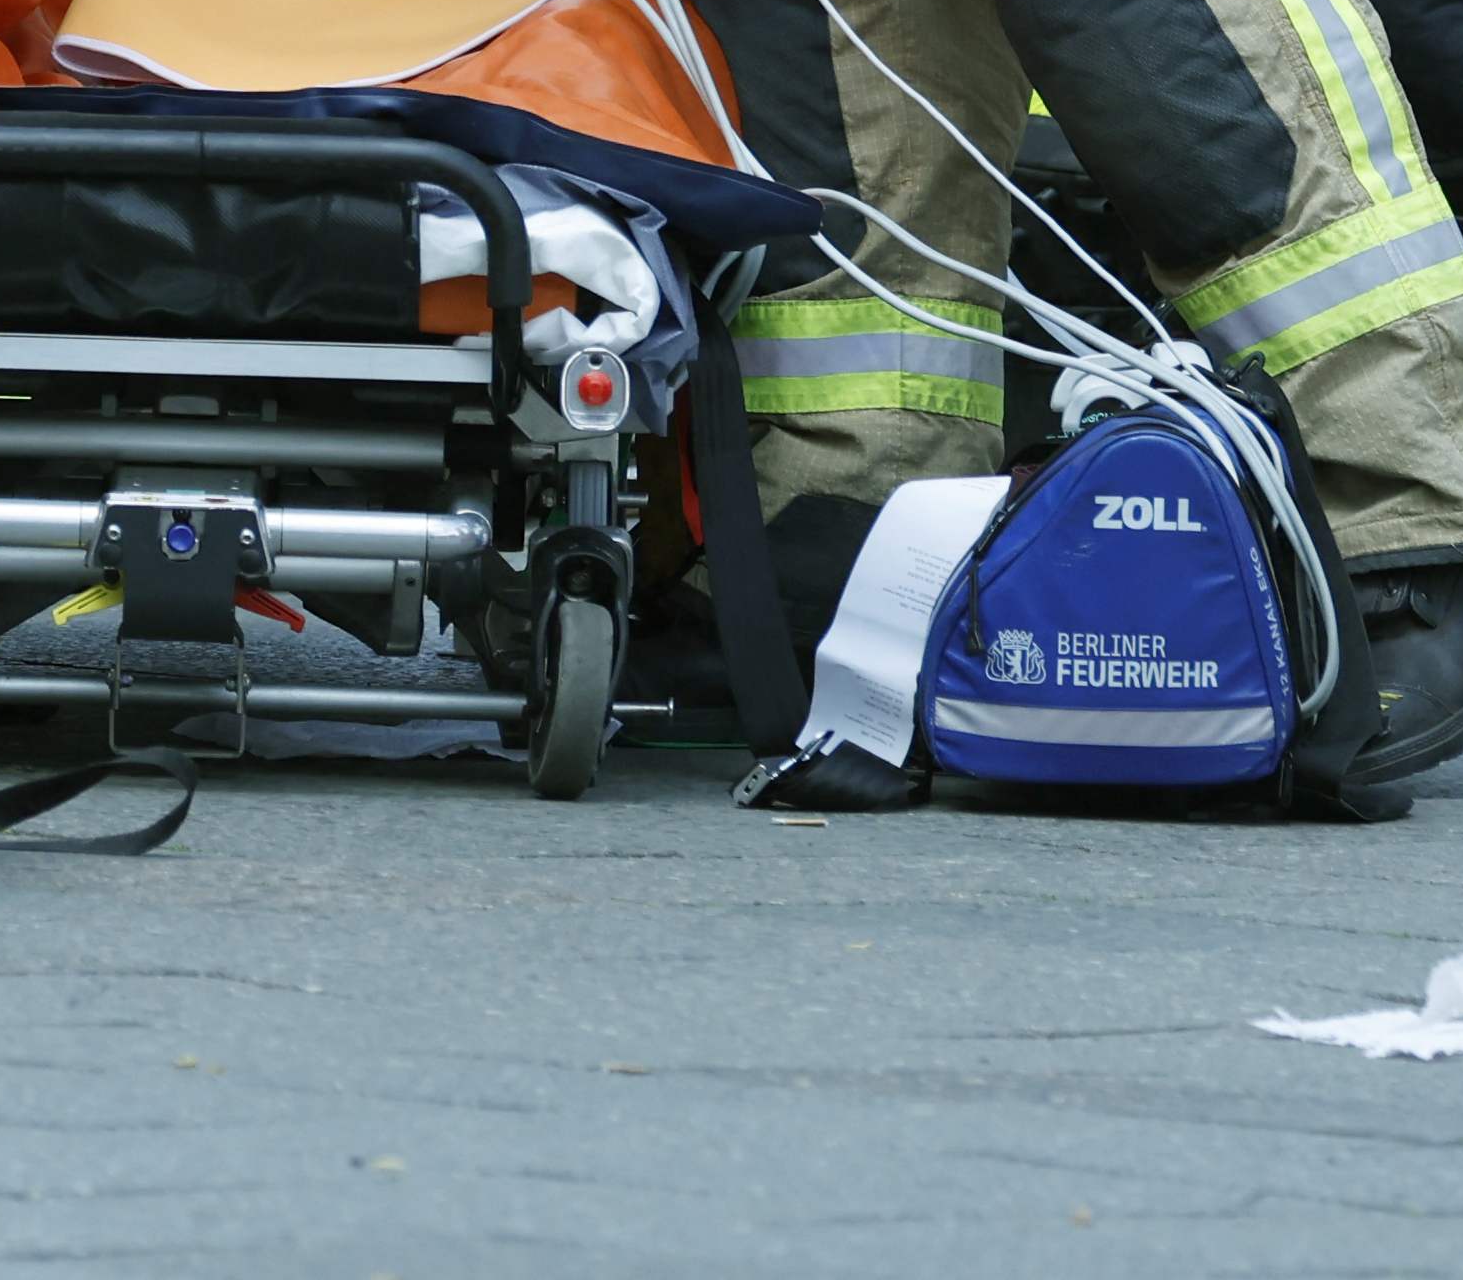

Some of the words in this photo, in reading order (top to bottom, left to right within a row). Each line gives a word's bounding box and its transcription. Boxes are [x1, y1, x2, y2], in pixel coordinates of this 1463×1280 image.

[1093, 495, 1202, 532] ZOLL
[1056, 632, 1167, 659] BERLINER
[1264, 596, 1286, 669] KANAL
[1056, 659, 1219, 689] FEUERWEHR
